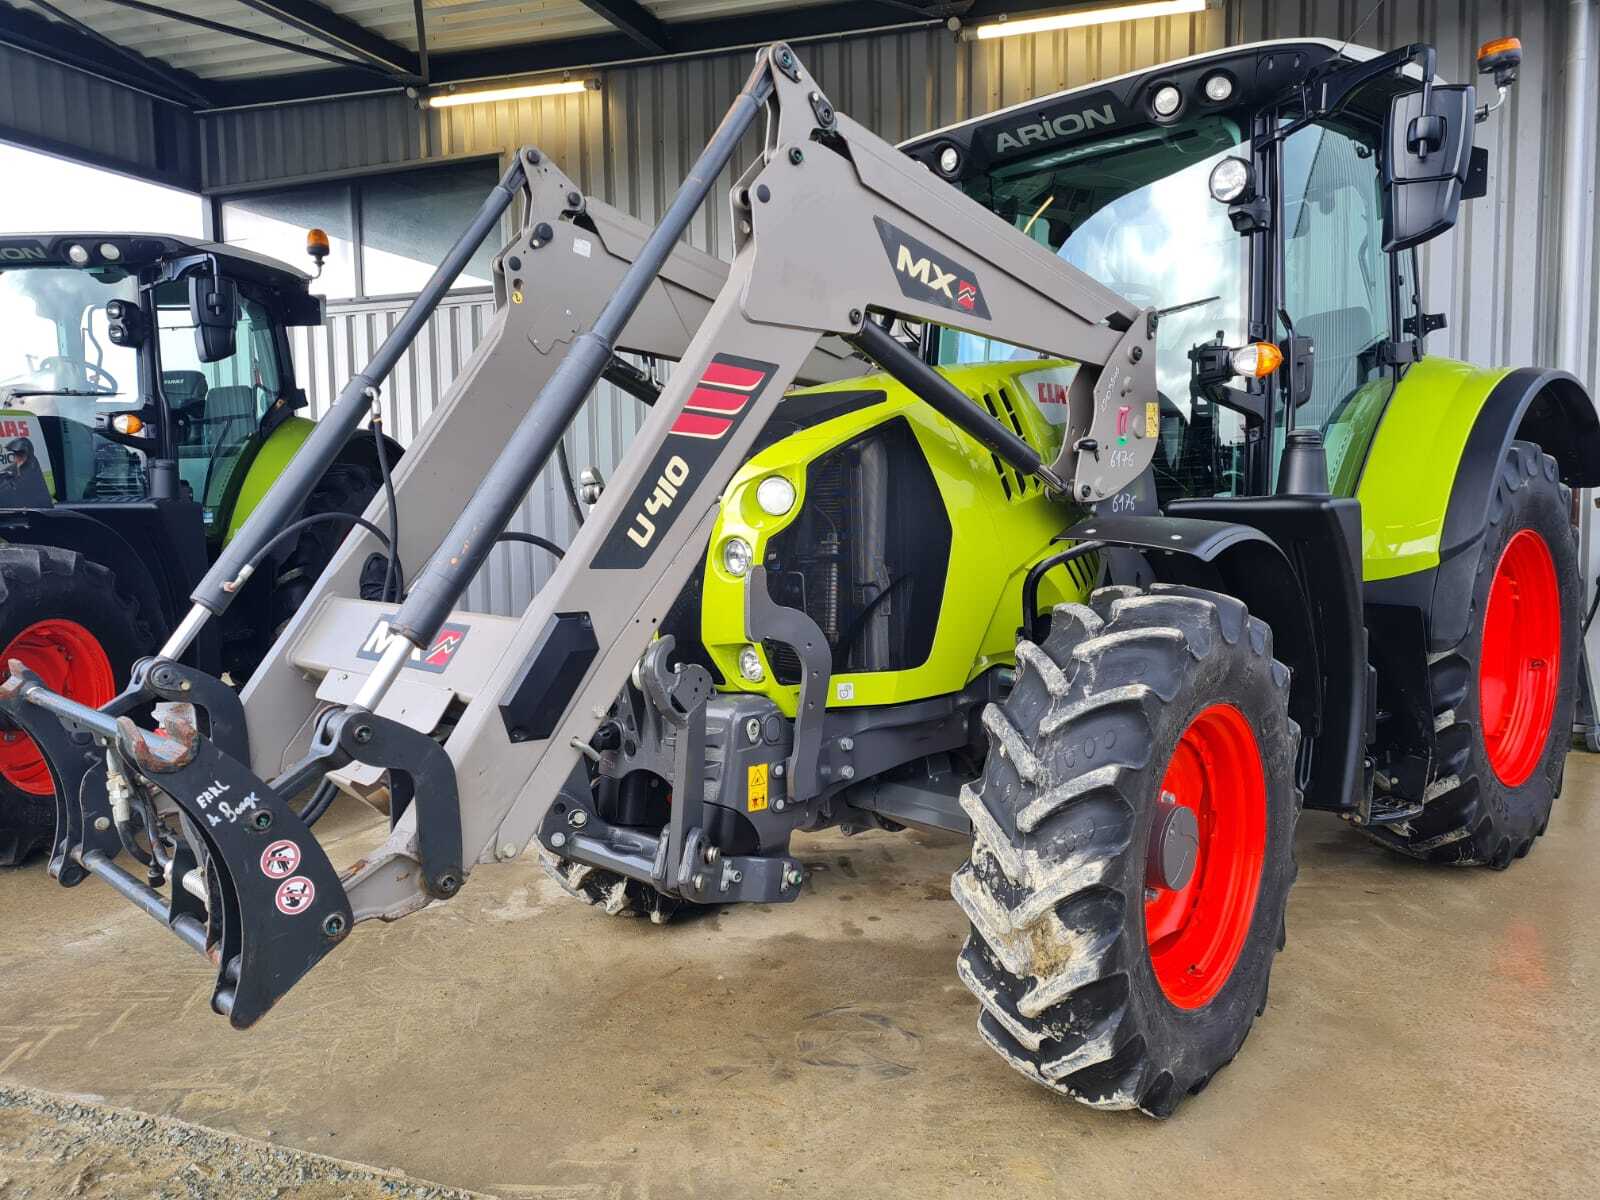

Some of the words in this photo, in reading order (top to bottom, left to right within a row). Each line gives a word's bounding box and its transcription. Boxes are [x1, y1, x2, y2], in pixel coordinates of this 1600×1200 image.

[897, 244, 957, 299] MX
[627, 512, 656, 548] U
[644, 455, 690, 516] 410
